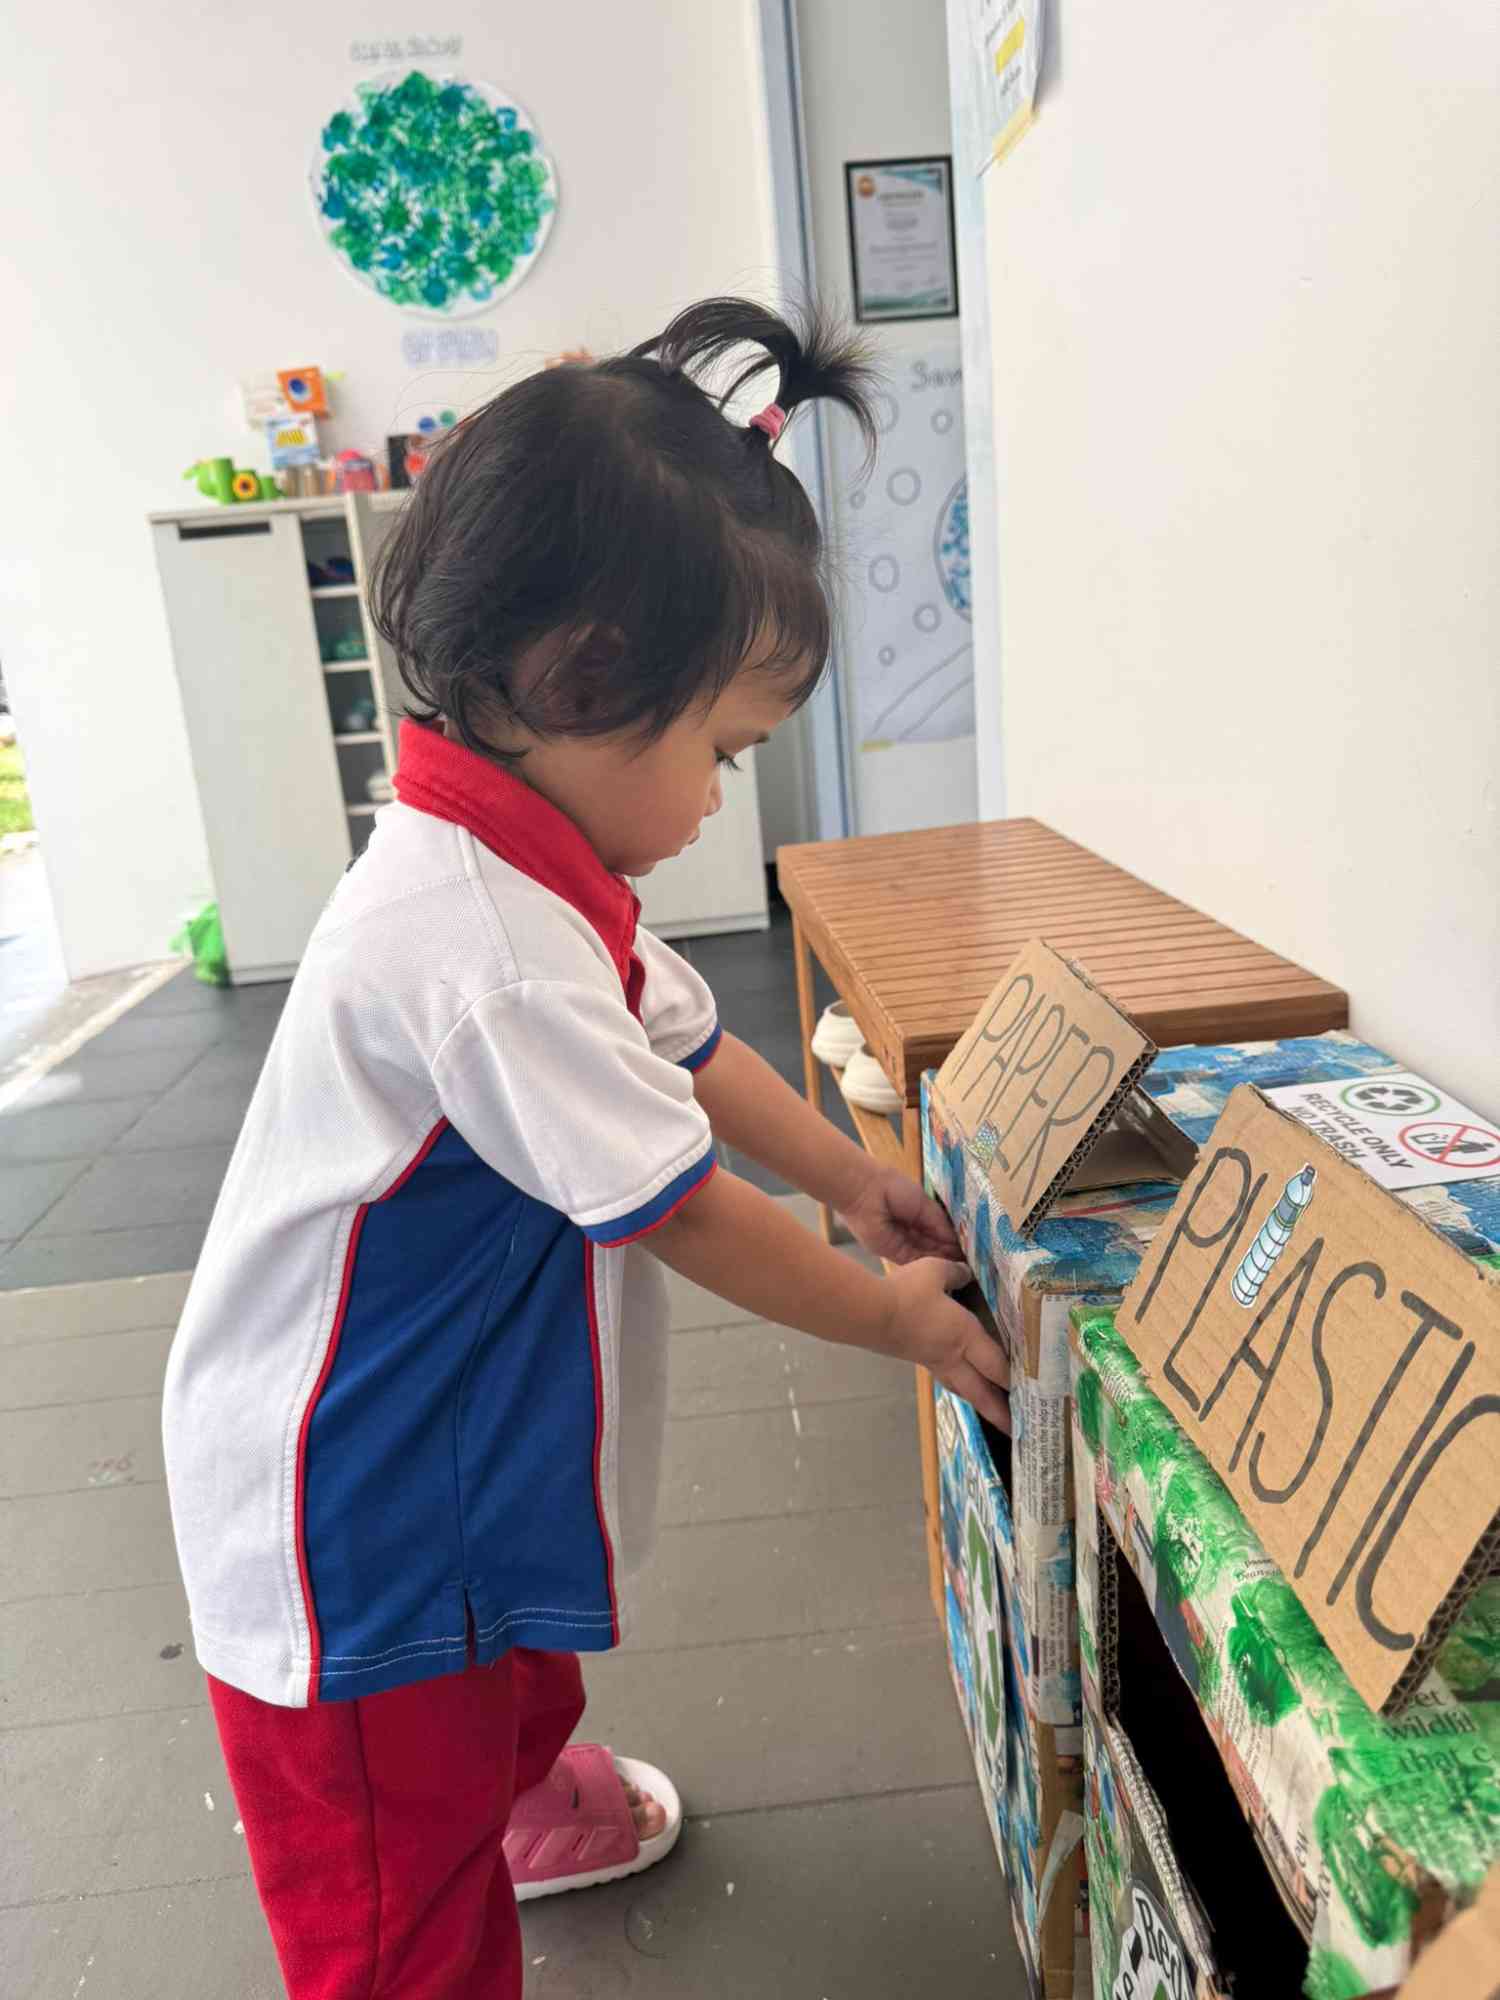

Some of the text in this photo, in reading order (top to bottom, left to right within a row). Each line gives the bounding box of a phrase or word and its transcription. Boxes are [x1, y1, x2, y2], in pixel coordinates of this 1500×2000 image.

[951, 974, 1115, 1208] PAPER
[1287, 1105, 1368, 1159] NO TRASH
[1300, 1092, 1415, 1169] RECYCLE ONLY
[1134, 1146, 1500, 1651] PLASTIC
